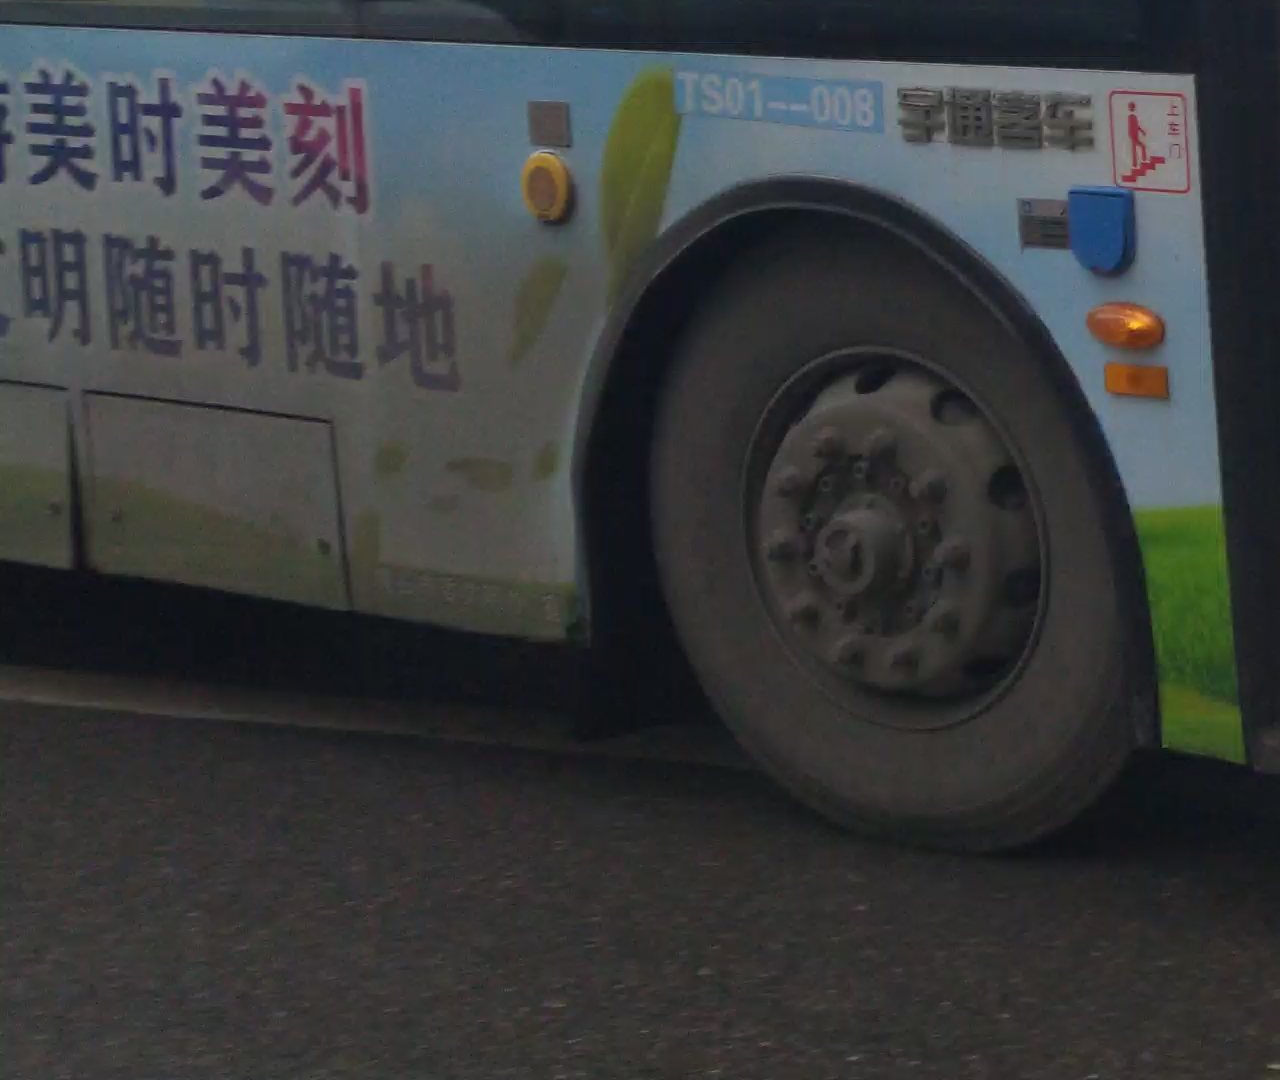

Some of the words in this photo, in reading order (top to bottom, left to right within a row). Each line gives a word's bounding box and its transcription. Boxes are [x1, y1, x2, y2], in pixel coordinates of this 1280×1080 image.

[0, 69, 371, 215] 美时美刻
[0, 228, 462, 393] 明随时随地
